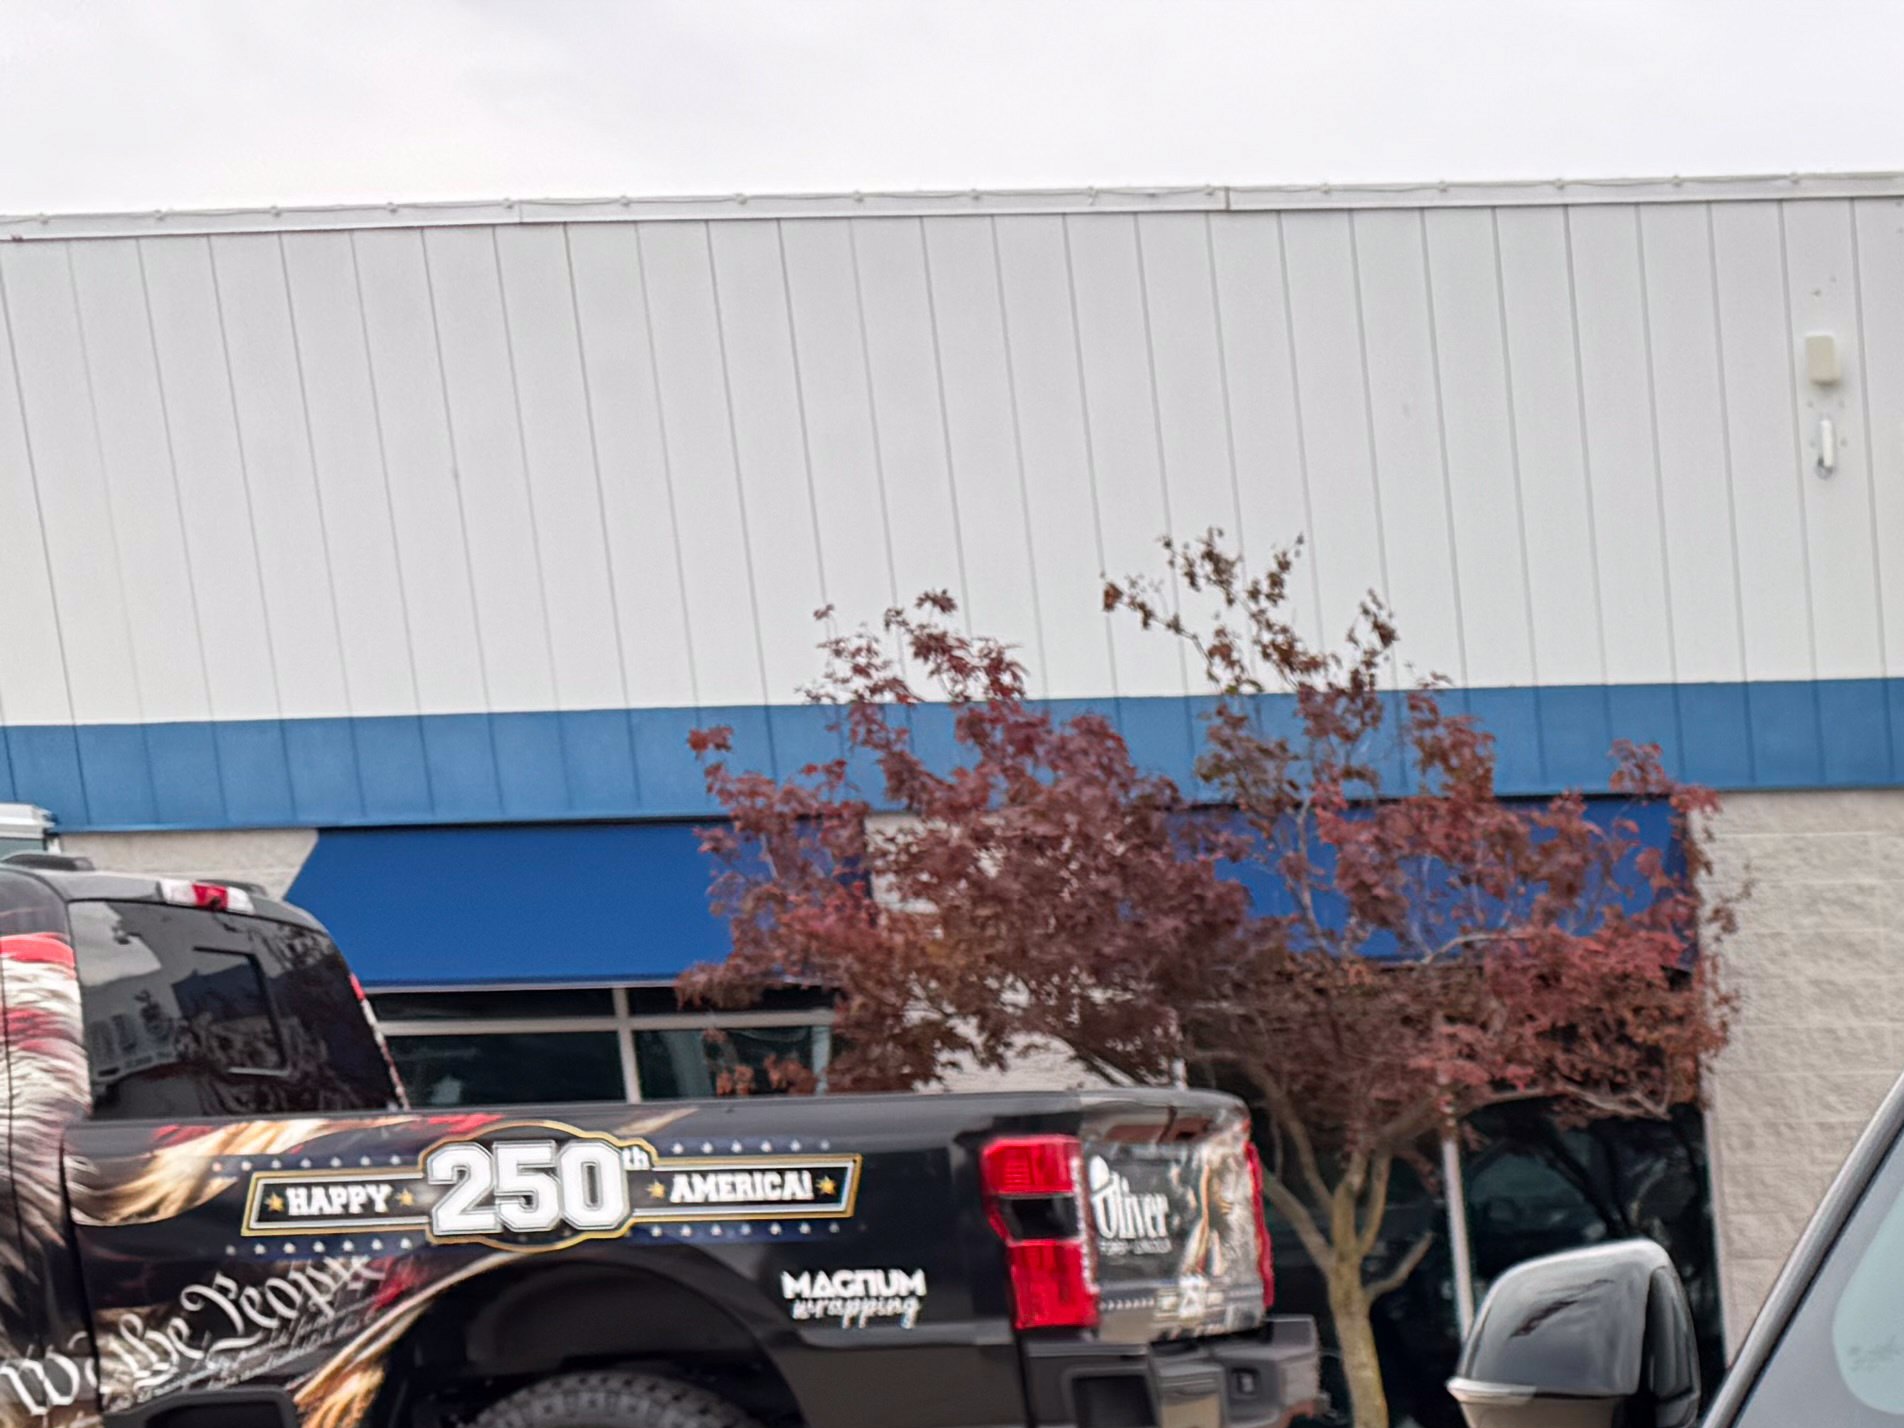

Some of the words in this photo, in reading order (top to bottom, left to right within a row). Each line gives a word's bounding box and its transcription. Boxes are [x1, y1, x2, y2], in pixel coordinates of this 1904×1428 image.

[285, 1184, 392, 1216] HAPPY
[669, 1169, 815, 1203] AMERICA!
[780, 1268, 927, 1299] MAGNUM
